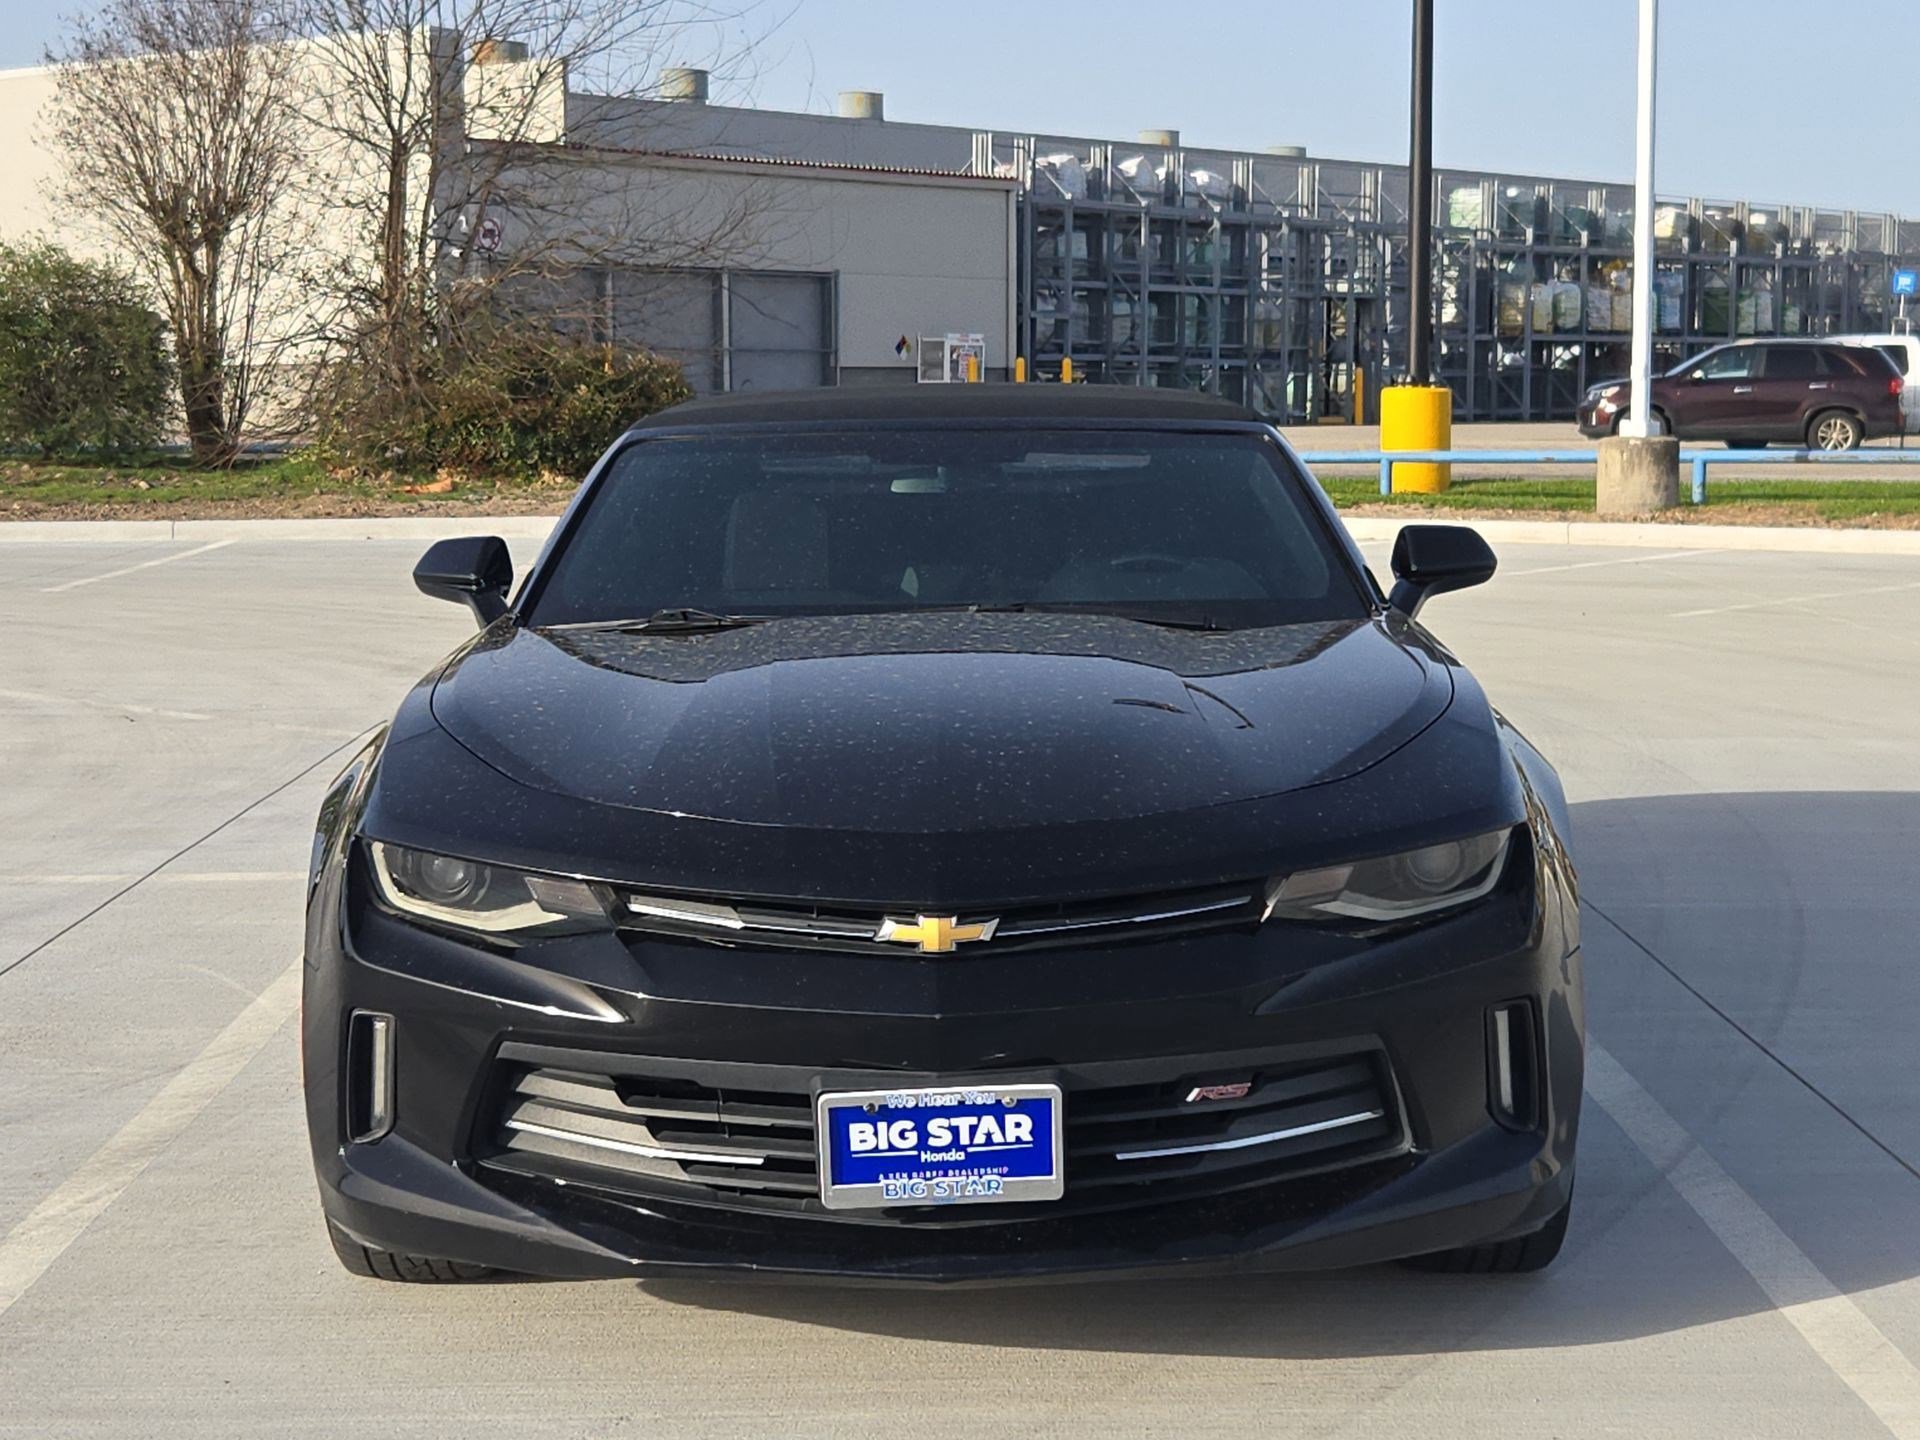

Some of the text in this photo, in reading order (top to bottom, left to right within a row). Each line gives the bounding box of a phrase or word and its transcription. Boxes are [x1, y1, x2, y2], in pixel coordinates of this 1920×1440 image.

[887, 1090, 996, 1109] We Hear You
[849, 1114, 1033, 1152] BIG STAR
[920, 1148, 965, 1163] Honda
[884, 1175, 1004, 1198] BIG STAR
